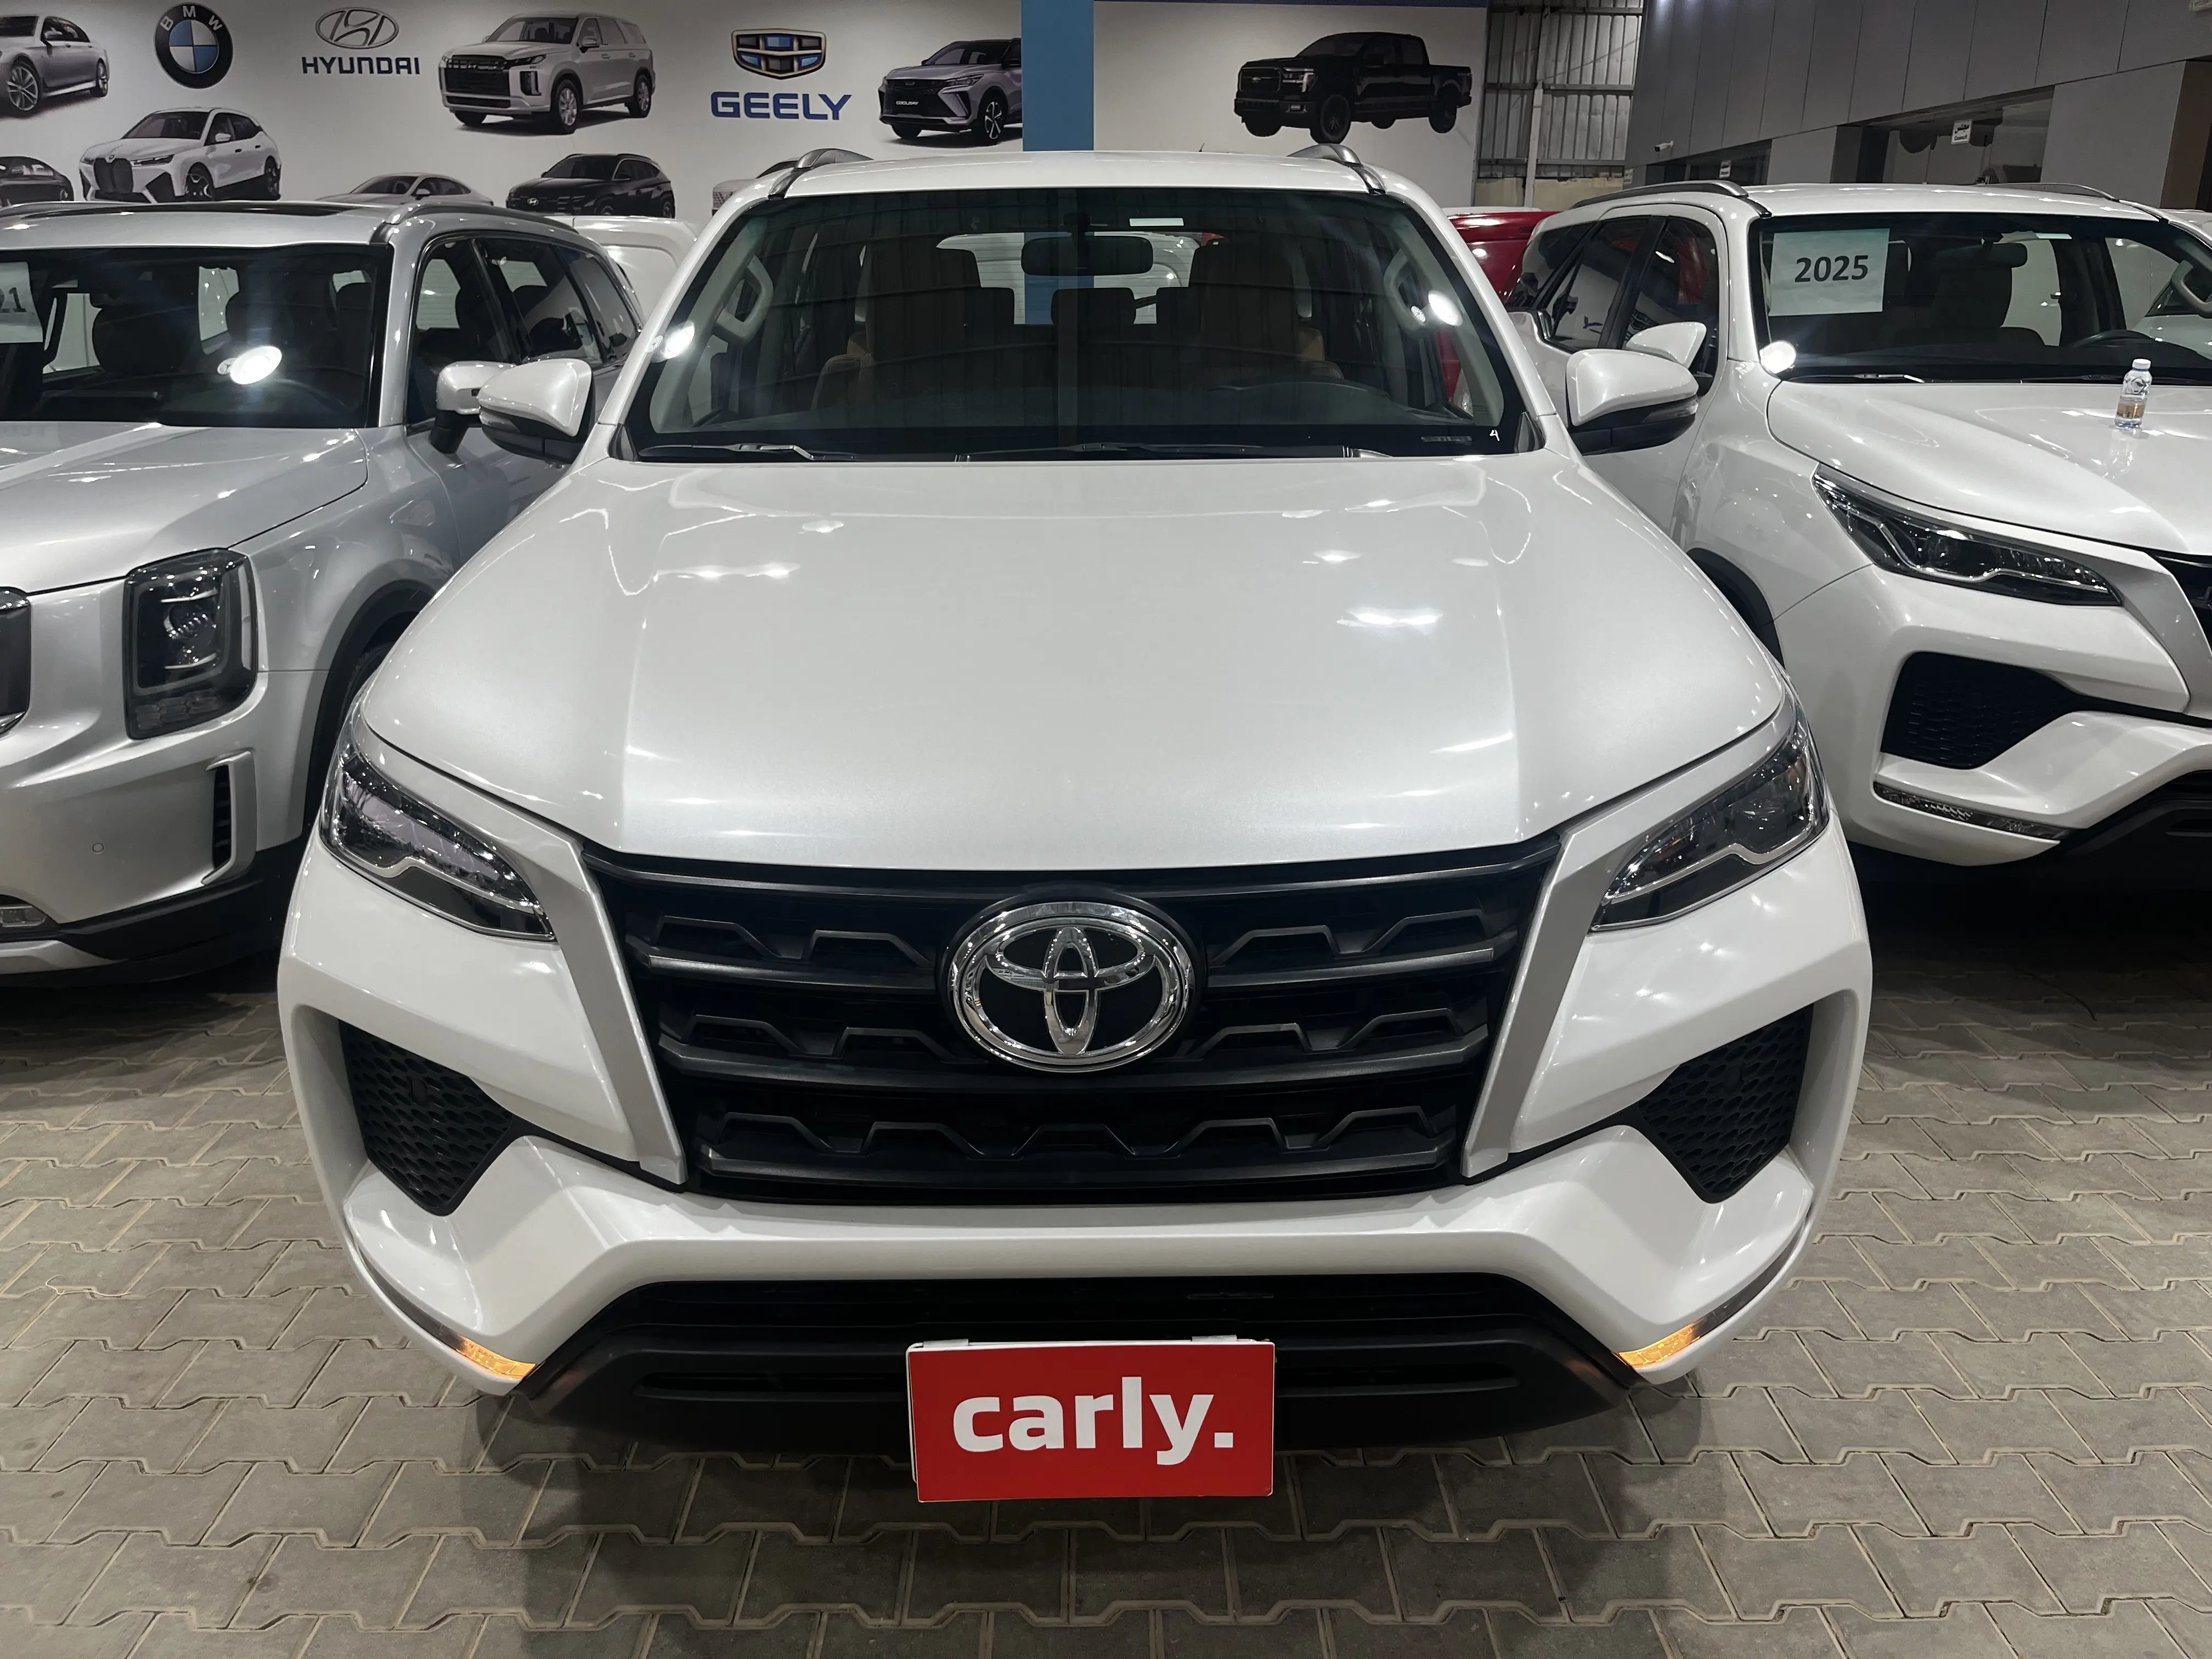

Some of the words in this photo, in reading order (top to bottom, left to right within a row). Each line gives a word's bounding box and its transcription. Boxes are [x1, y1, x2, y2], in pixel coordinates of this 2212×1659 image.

[160, 5, 223, 31] BMW
[301, 57, 420, 75] HYUNDAI
[711, 91, 853, 120] GEELY
[1795, 255, 1869, 283] 2025
[953, 1376, 1234, 1465] carly.
